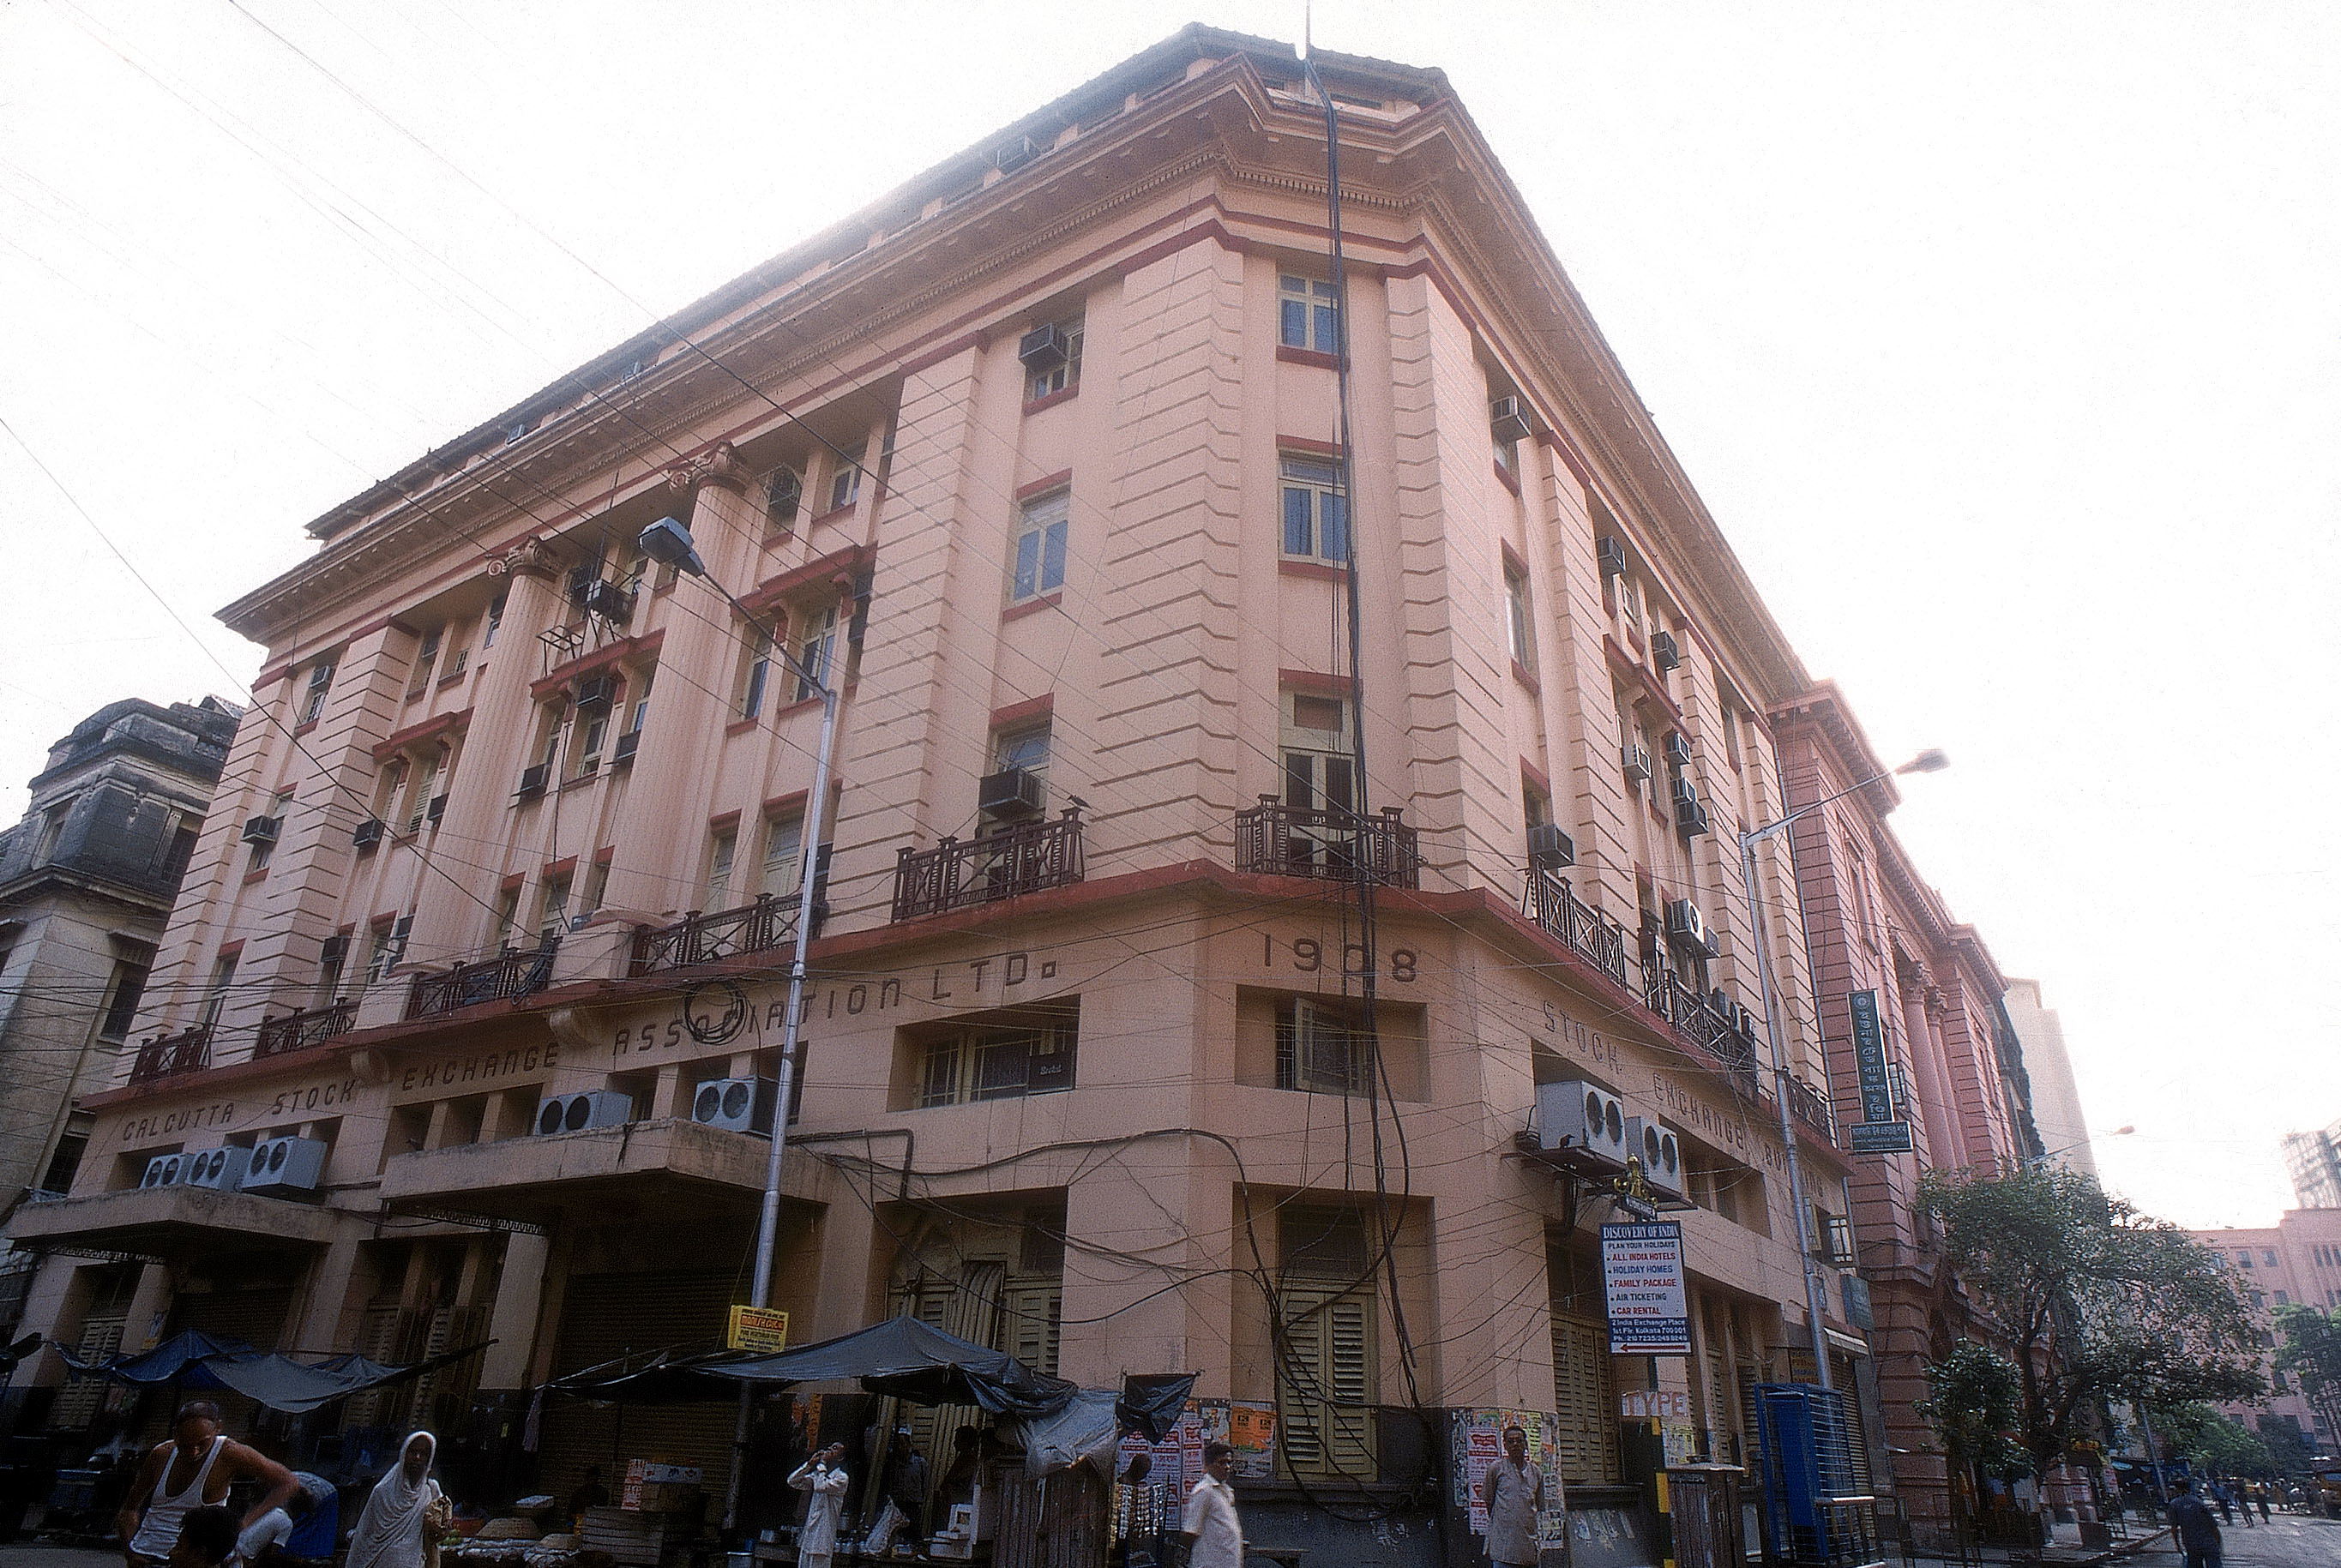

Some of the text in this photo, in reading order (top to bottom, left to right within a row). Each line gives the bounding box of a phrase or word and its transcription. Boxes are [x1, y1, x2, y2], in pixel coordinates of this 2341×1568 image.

[1543, 1000, 1621, 1075] STOCK
[1652, 1072, 1748, 1150] EXCHANGE
[123, 1102, 234, 1141] CALCUTTA
[271, 1078, 357, 1115] STOCK
[401, 1042, 559, 1091] EXCHANGE
[1604, 1225, 1679, 1239] DISCOVERY OF INDIA
[1613, 1265, 1673, 1274] HOLIDAY HOMES
[1614, 1278, 1677, 1288] FAMILY PACKAGE
[1616, 1293, 1667, 1301] AIR TICKETING
[1634, 1319, 1666, 1328] Exchange
[1622, 1390, 1688, 1417] TYPE
